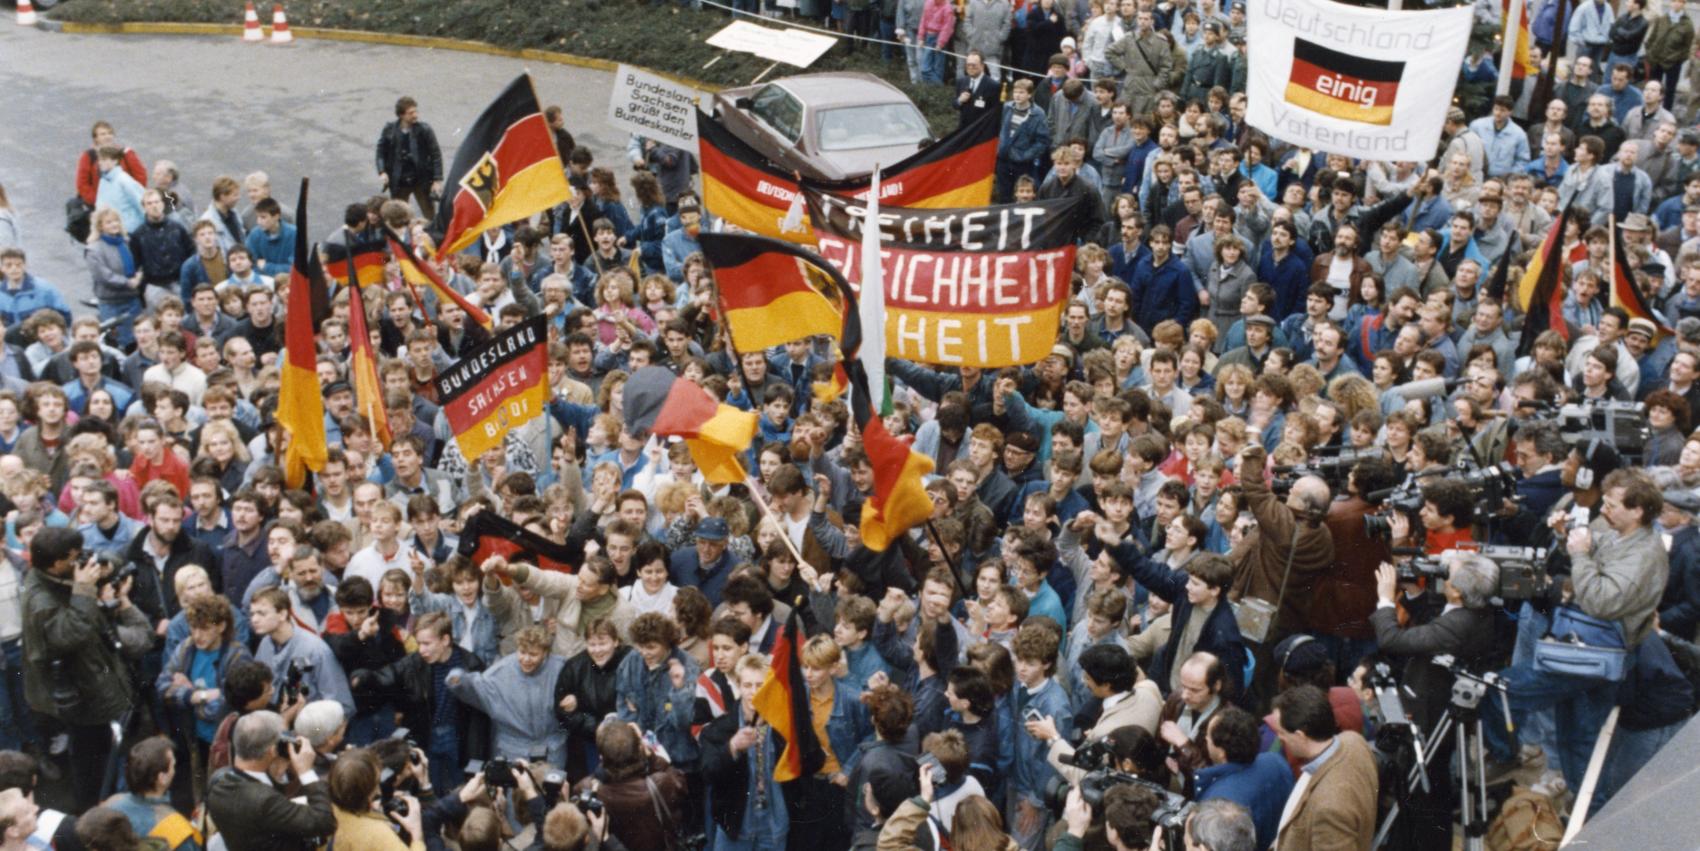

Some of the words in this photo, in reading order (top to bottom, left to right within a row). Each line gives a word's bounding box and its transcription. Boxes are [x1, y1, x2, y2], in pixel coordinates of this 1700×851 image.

[1264, 0, 1434, 50] Deutschland
[631, 88, 689, 115] Sachsen
[1315, 73, 1378, 109] einig
[615, 106, 694, 140] Bundeskanzler
[628, 102, 661, 117] grüßt
[662, 111, 685, 126] den
[1270, 102, 1409, 151] Vaterland
[884, 313, 1032, 364] HEIT
[441, 326, 536, 395] BUNDESLAND
